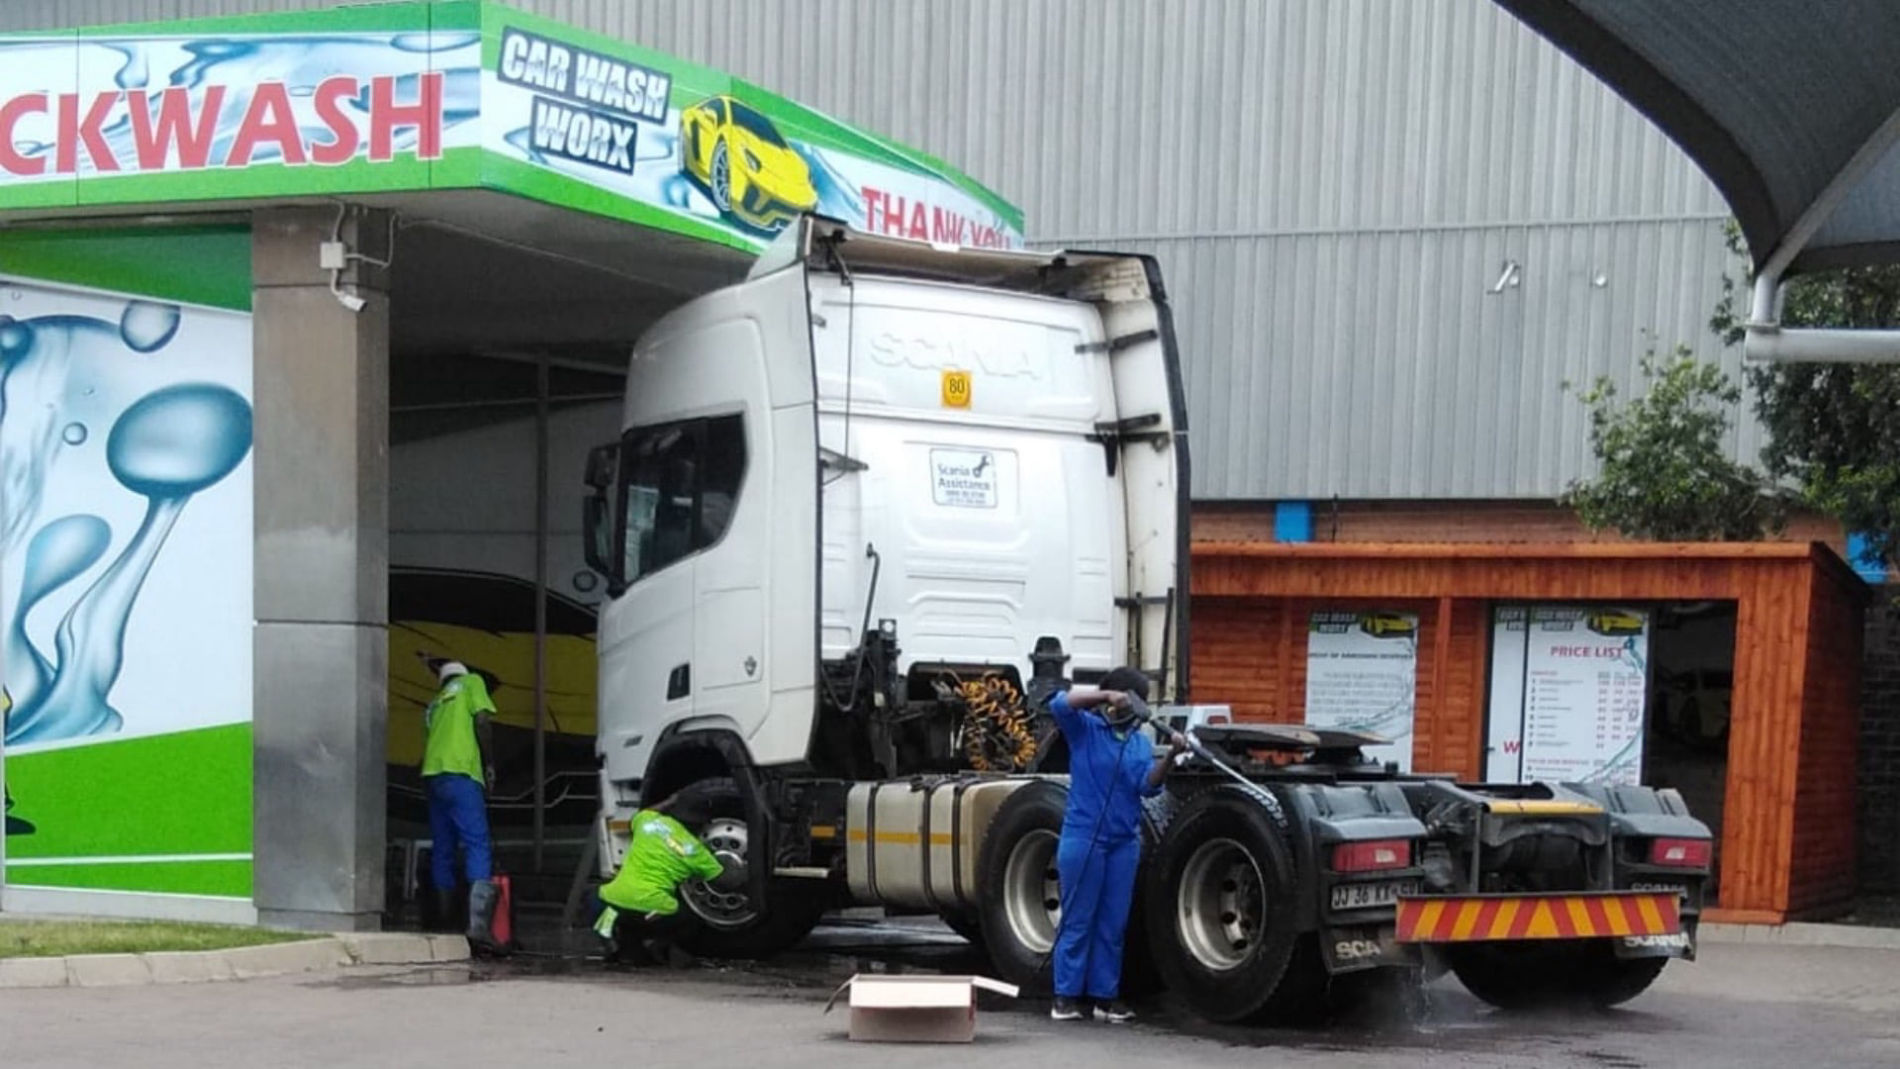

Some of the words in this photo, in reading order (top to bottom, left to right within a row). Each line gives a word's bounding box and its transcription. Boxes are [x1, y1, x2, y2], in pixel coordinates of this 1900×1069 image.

[502, 33, 570, 93] CAR
[575, 52, 669, 120] WASH
[0, 72, 443, 175] CKWASH
[534, 102, 634, 170] WORX
[861, 186, 965, 246] THANK
[937, 463, 971, 476] Scania
[1550, 645, 1590, 658] PRICE
[1595, 646, 1624, 659] LIST
